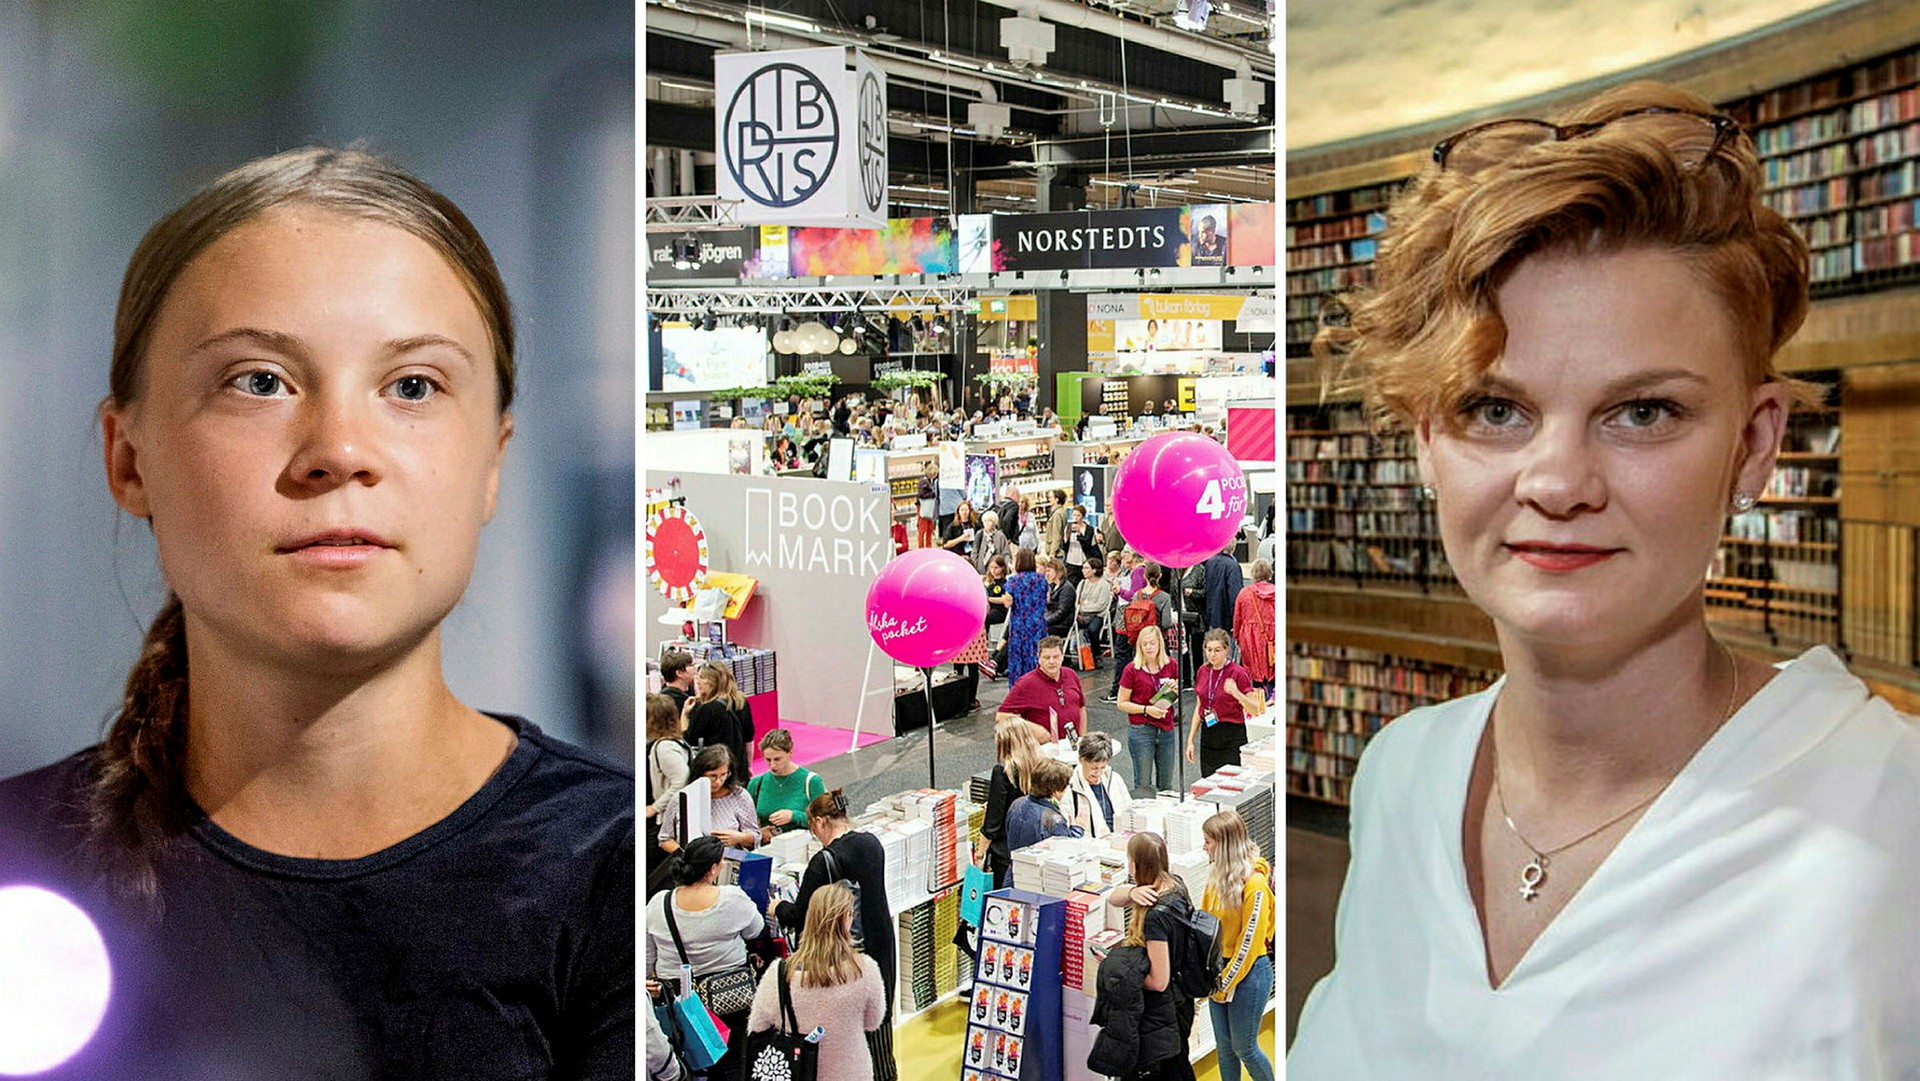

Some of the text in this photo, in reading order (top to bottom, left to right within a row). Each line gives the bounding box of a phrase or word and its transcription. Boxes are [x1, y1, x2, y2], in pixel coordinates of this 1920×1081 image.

[1018, 226, 1165, 252] NORSTEDTS
[1096, 305, 1125, 313] NONA
[778, 491, 881, 535] BOOK
[1196, 476, 1245, 519] 4 POC
[778, 533, 881, 577] MARK
[882, 616, 928, 646] pocket
